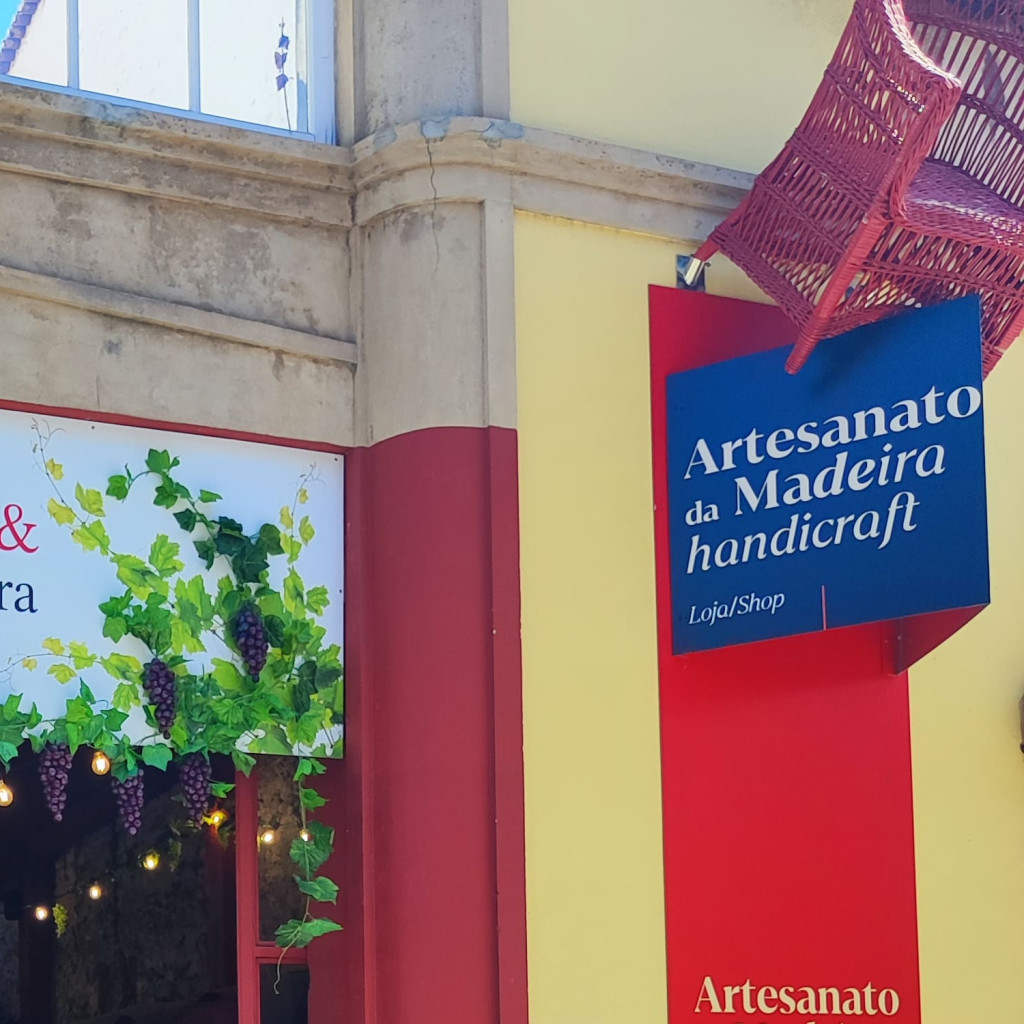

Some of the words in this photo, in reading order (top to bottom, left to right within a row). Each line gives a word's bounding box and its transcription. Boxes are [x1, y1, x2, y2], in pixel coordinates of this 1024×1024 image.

[683, 385, 982, 479] Artesanato
[685, 500, 719, 526] da
[734, 443, 946, 515] Madeira
[686, 491, 921, 574] handicraft
[688, 592, 786, 627] Loja/Shop
[694, 976, 900, 1016] Artesanato
